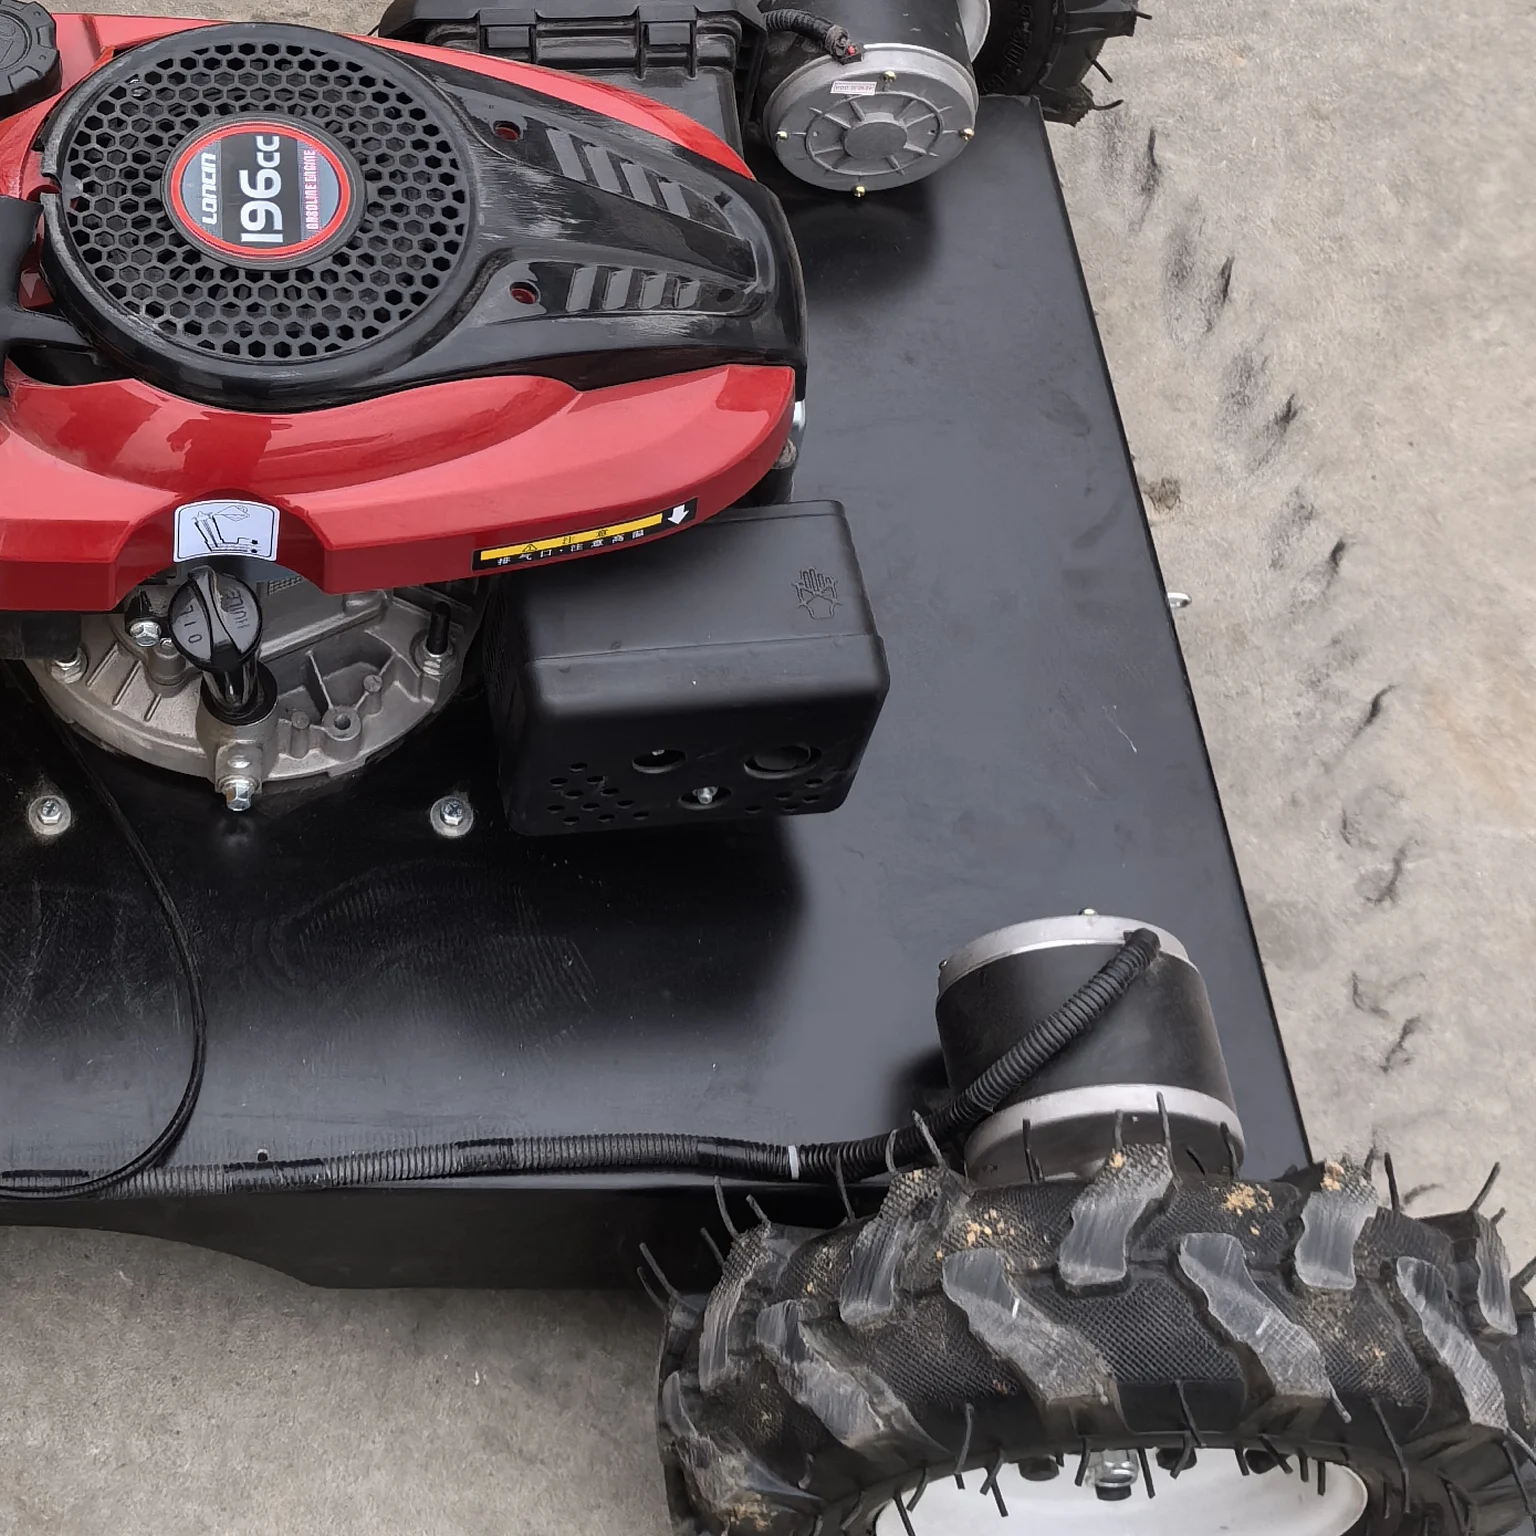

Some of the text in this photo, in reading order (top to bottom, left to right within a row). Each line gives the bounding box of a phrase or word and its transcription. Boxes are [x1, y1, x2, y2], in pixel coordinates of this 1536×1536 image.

[239, 135, 284, 244] 196cc
[179, 604, 203, 644] OIL
[226, 586, 251, 630] HUILE
